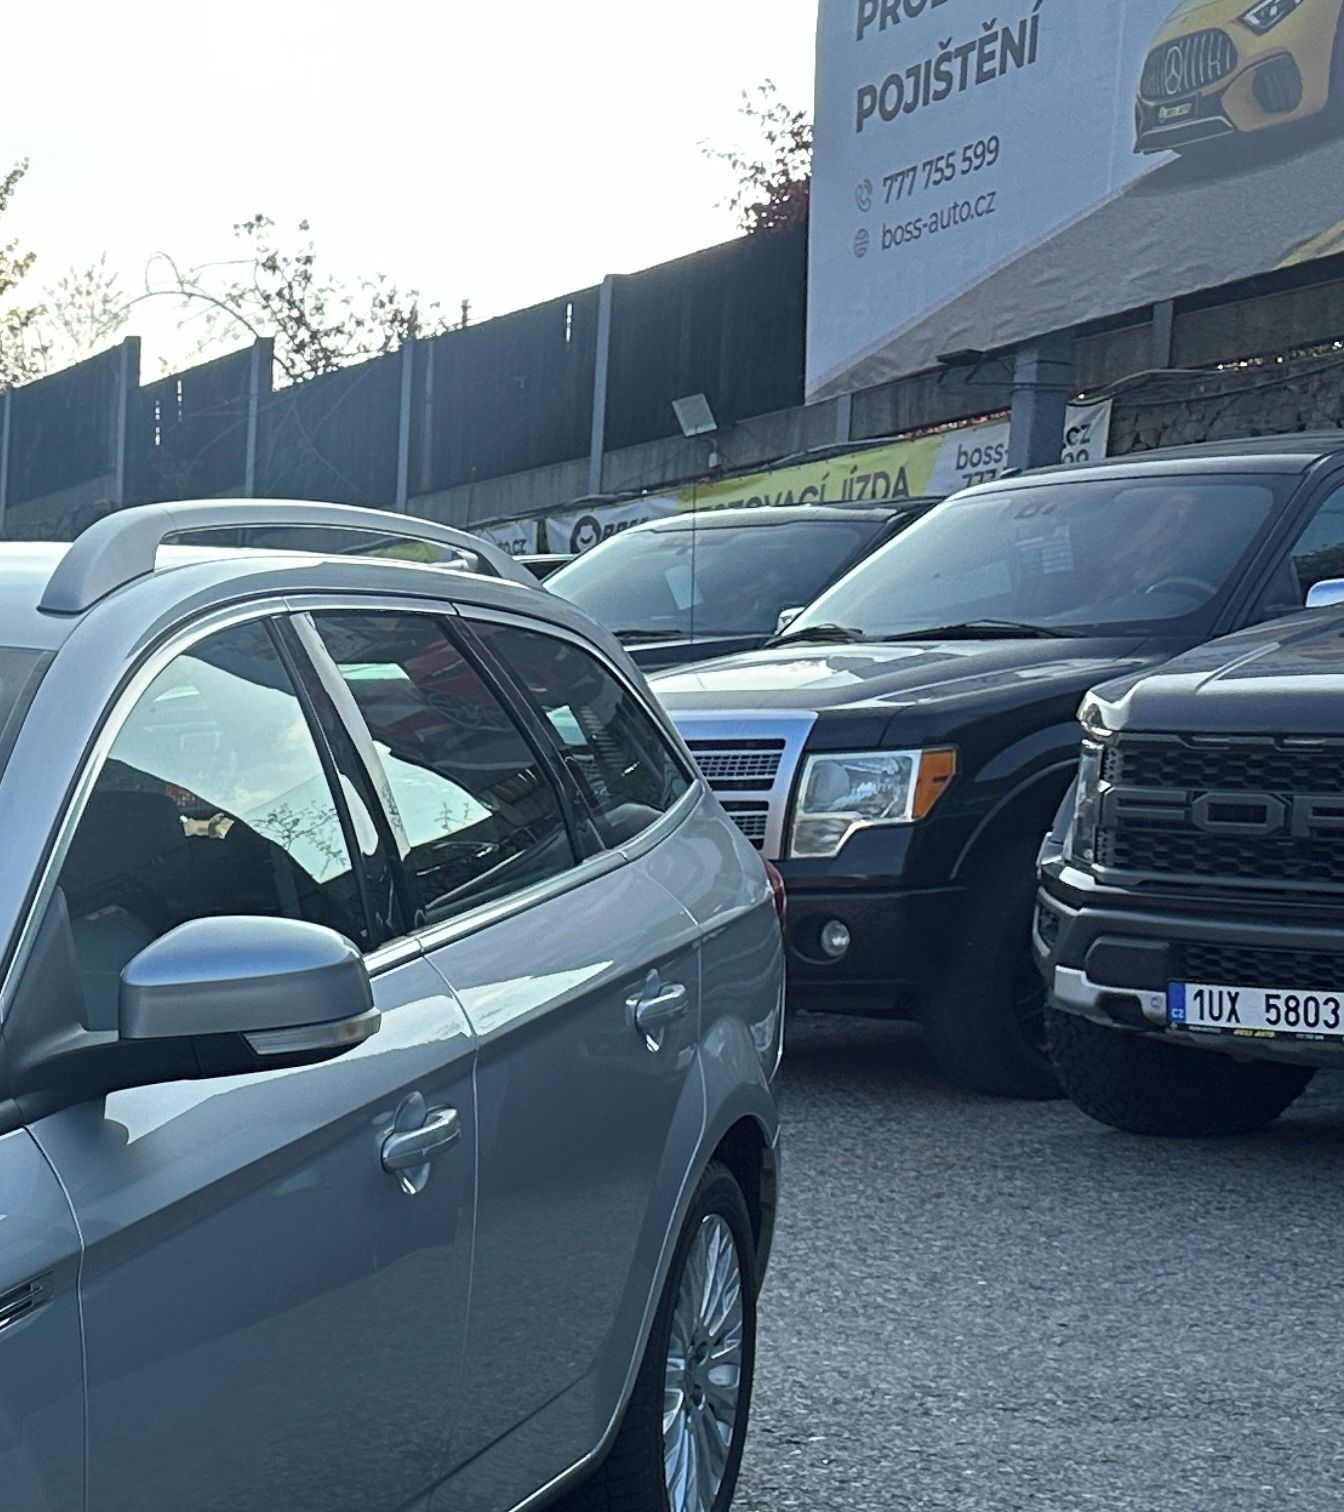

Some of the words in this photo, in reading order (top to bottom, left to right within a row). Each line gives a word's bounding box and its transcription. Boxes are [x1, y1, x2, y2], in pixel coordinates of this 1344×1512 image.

[856, 0, 1043, 133] POJIŠTĚNÍ
[882, 166, 918, 205] 777
[922, 150, 956, 190] 755
[960, 135, 1000, 175] 599
[881, 191, 997, 251] boss-auto.cz
[841, 465, 910, 501] JÍZDA
[1171, 1007, 1185, 1019] CZ
[1193, 988, 1241, 1024] 1UX
[1265, 993, 1340, 1029] 5803
